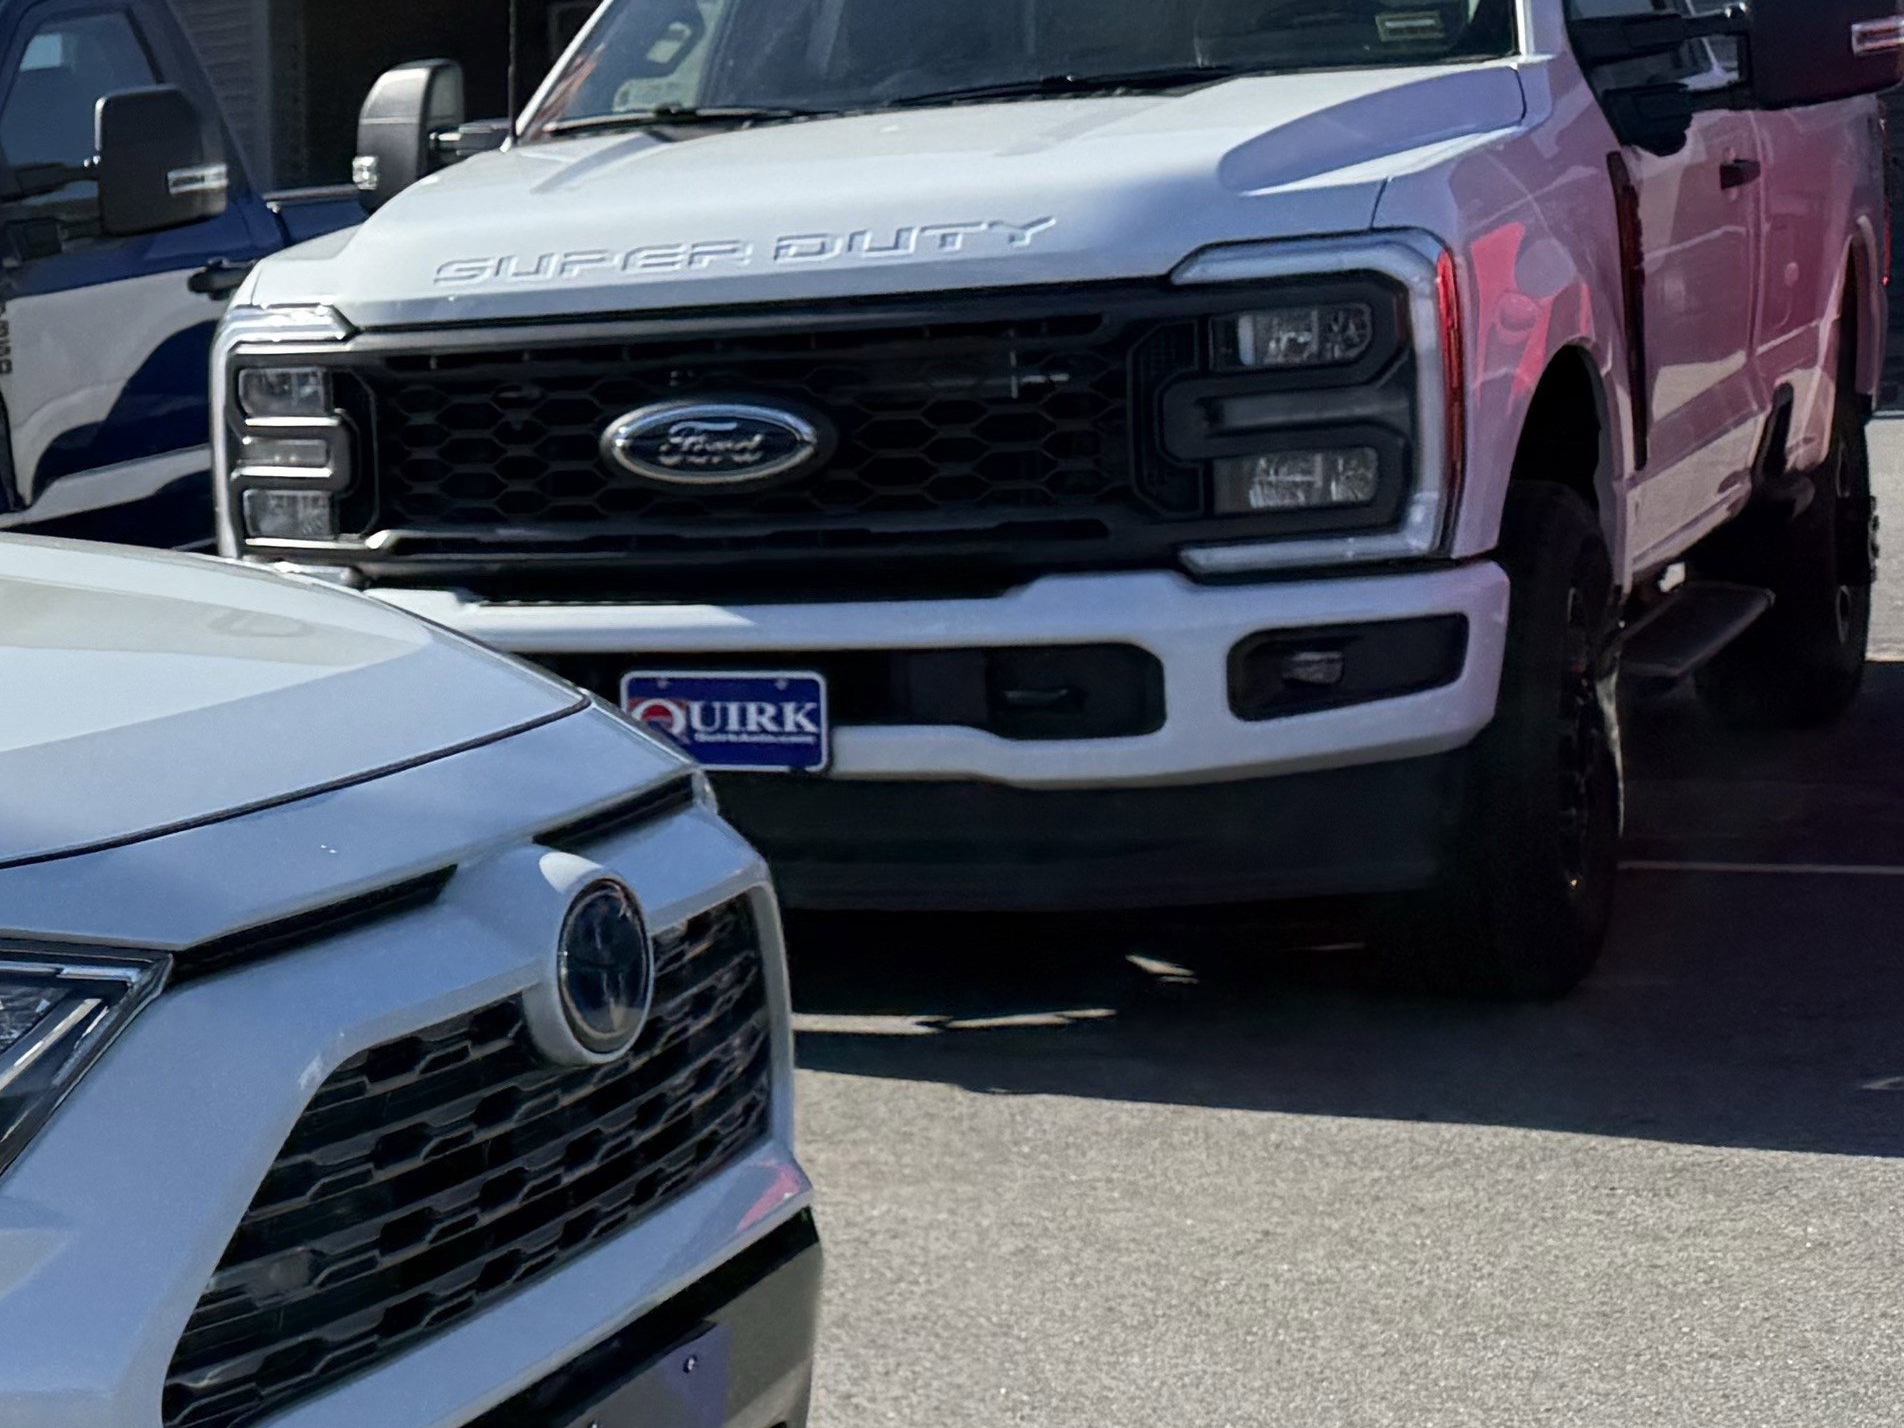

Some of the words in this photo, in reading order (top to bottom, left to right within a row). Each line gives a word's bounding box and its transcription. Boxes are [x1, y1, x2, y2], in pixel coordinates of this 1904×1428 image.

[432, 239, 750, 286] SUPER
[772, 215, 1058, 264] DUTY
[658, 420, 765, 467] Ford
